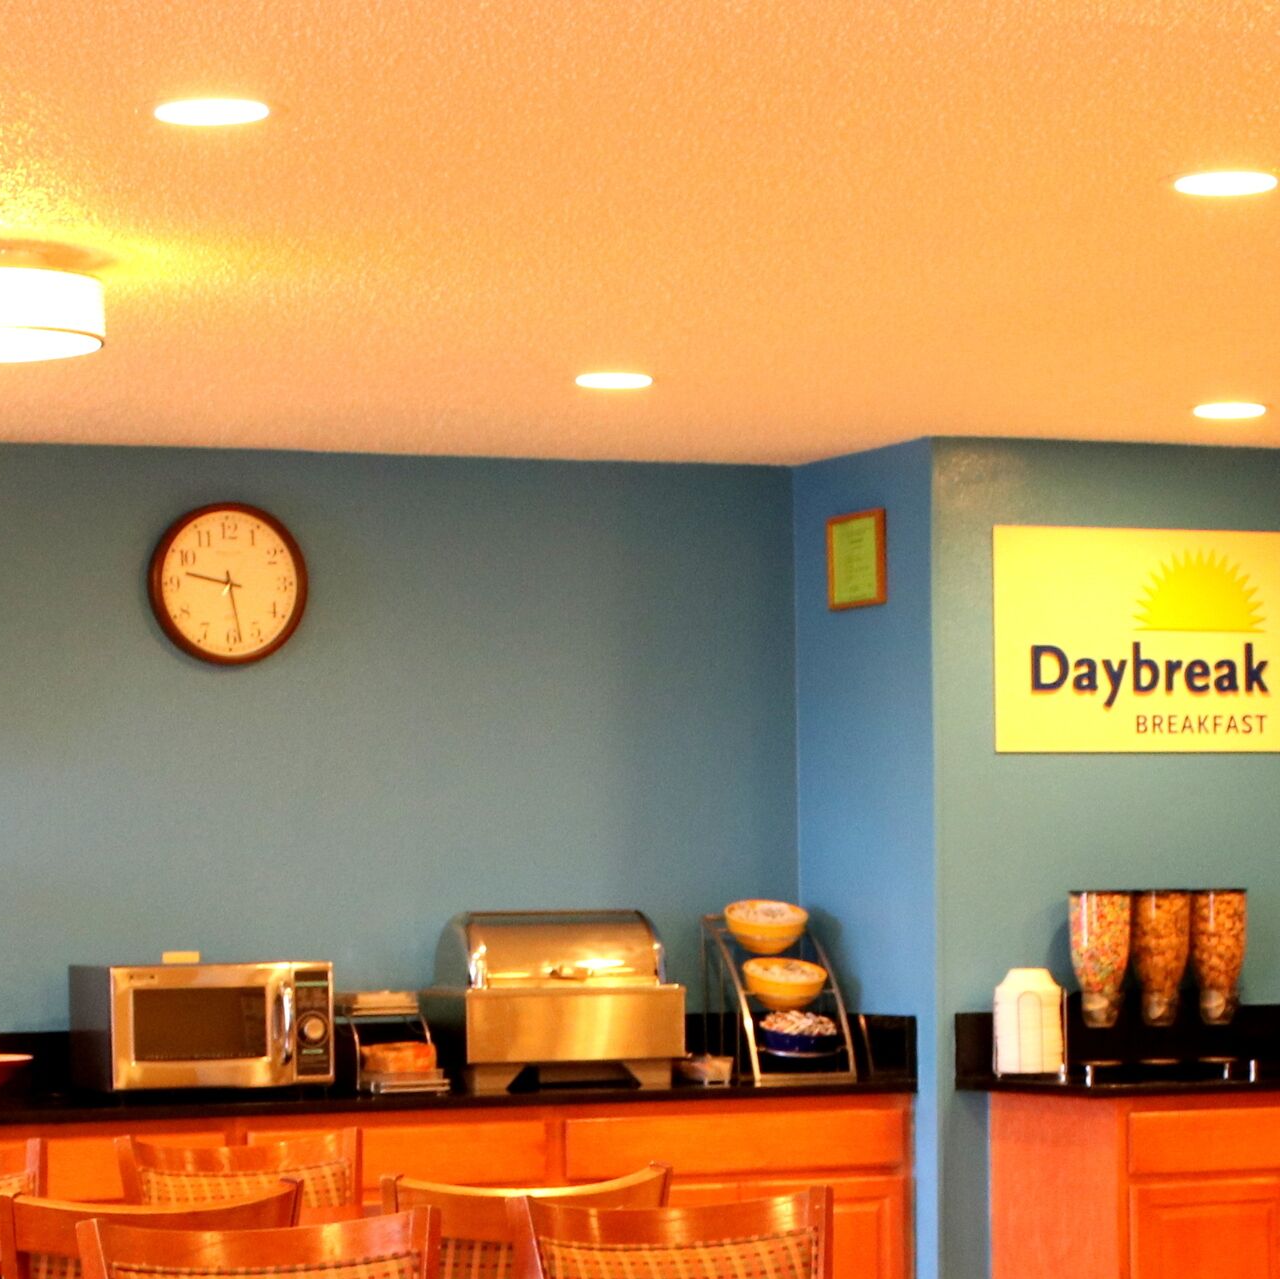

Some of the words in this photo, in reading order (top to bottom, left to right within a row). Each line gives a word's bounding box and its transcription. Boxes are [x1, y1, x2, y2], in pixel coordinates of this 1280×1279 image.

[197, 530, 211, 548] 11
[221, 522, 238, 540] 12
[180, 549, 196, 567] 10
[266, 548, 278, 565] 2
[169, 575, 180, 592] 9
[277, 576, 288, 591] 3
[267, 601, 277, 619] 4
[200, 622, 210, 640] 7
[226, 627, 238, 645] 6
[251, 620, 261, 637] 5
[1031, 641, 1269, 709] Daybreak
[1136, 714, 1267, 734] BREAKFAST
